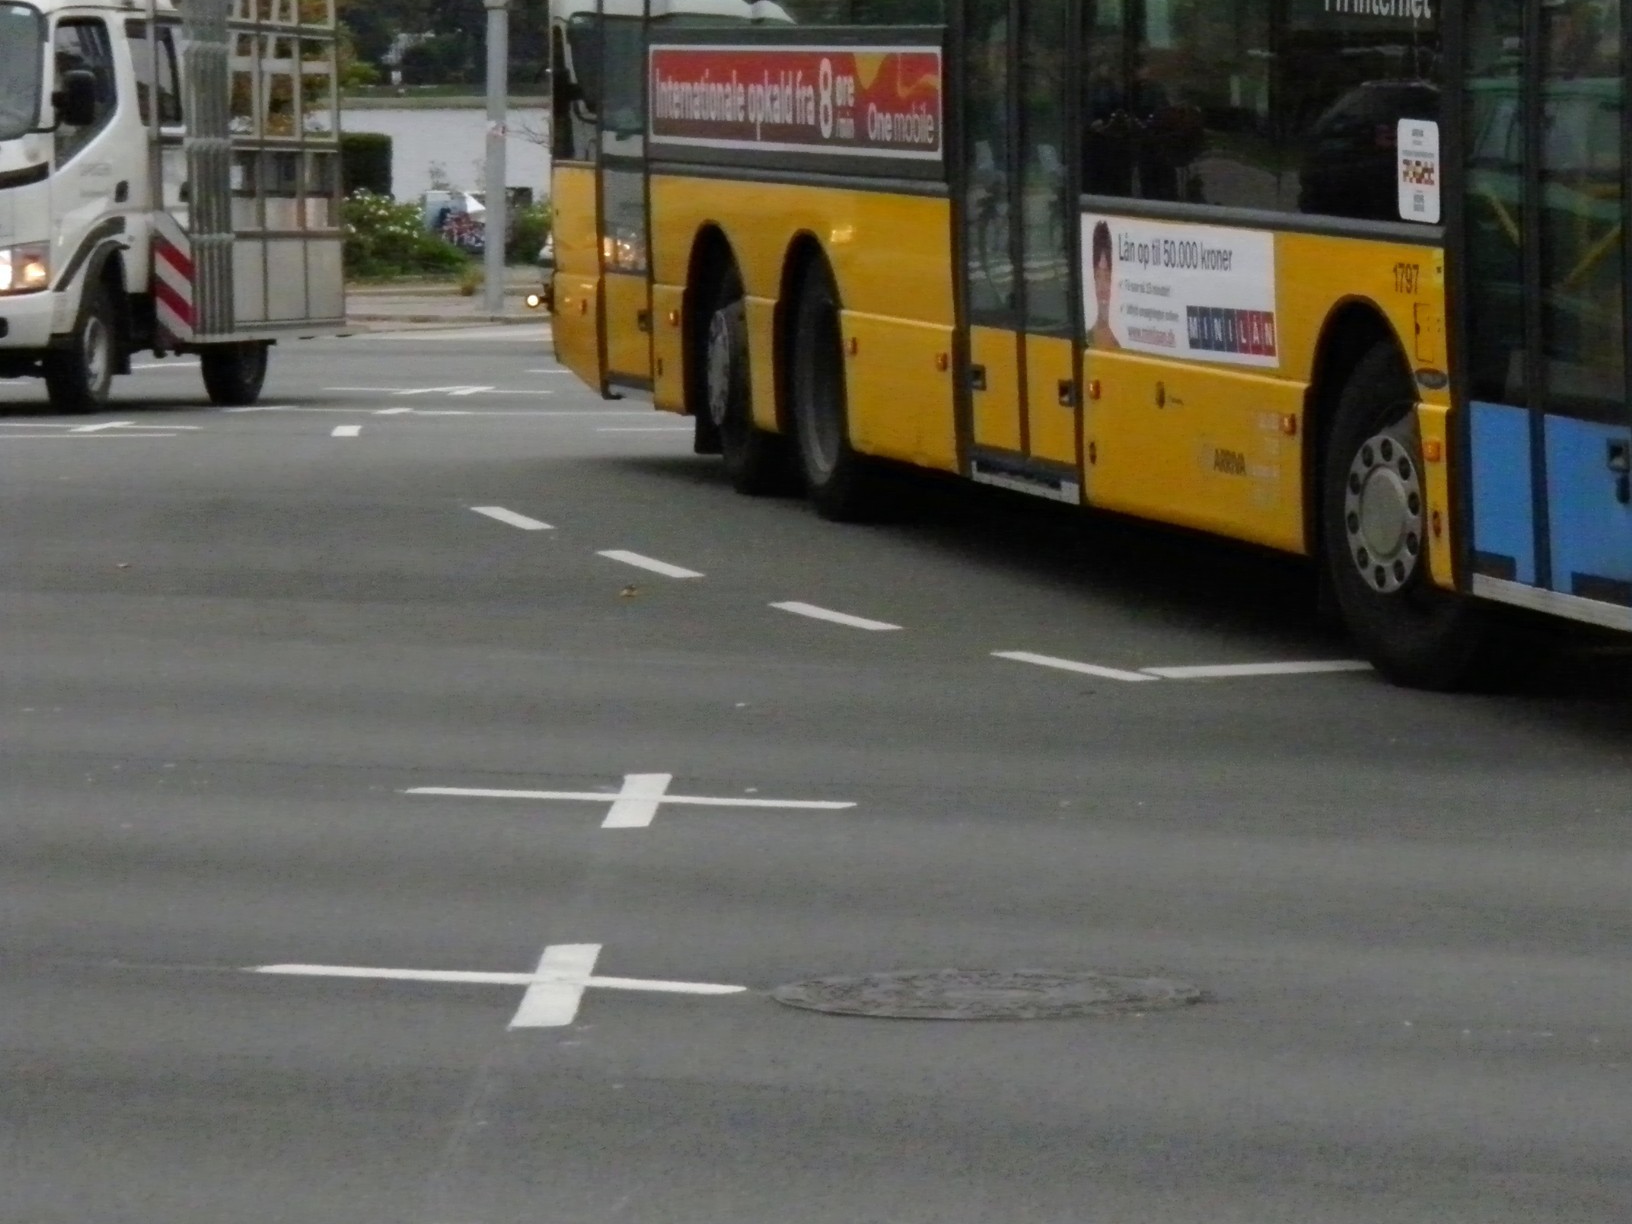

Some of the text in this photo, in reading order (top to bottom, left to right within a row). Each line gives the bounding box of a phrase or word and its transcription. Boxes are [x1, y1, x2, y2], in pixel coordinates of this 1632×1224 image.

[655, 58, 833, 142] Internationale opkald fra 8
[867, 101, 892, 143] One
[1118, 232, 1136, 262] Lån
[1137, 240, 1149, 271] op
[1163, 239, 1198, 270] 50.000
[1200, 241, 1233, 272] kroner
